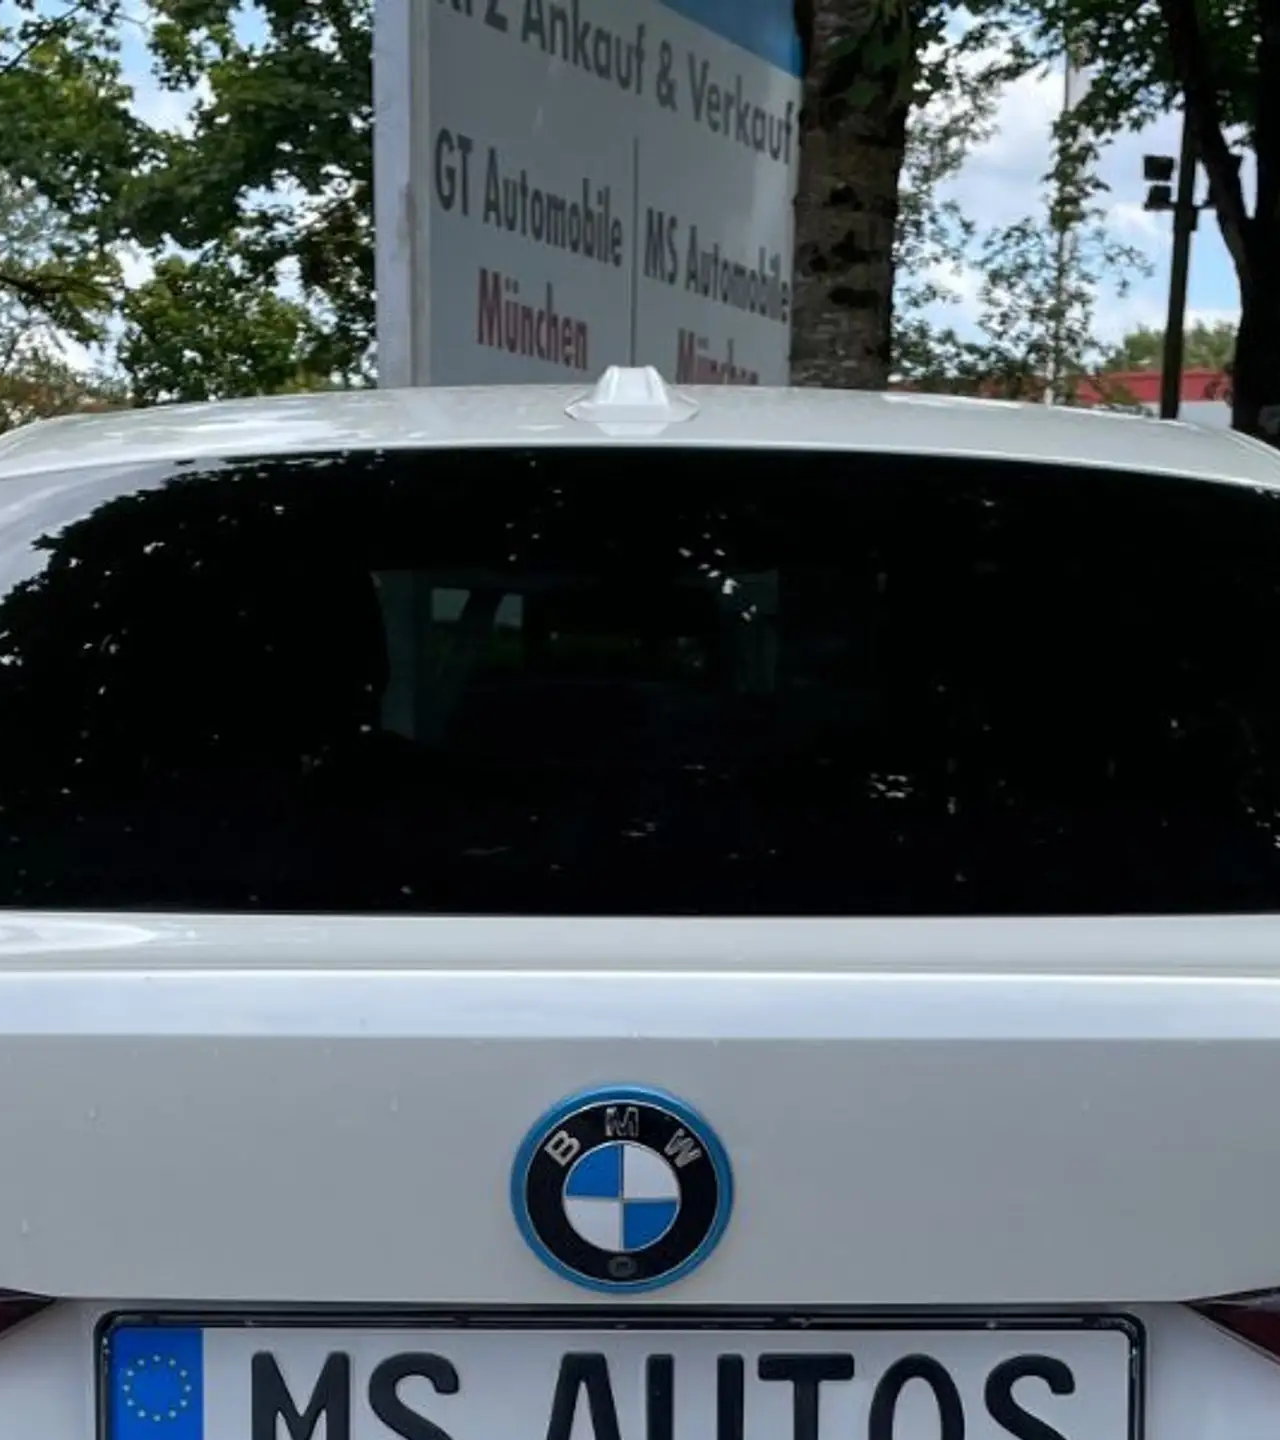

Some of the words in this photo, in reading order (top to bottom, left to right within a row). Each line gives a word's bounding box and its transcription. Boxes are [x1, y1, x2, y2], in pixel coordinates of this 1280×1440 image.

[521, 0, 646, 95] Ankauf
[655, 39, 678, 112] &
[687, 52, 794, 164] Verkauf
[434, 128, 474, 217] GT
[482, 146, 623, 268] Automobile
[476, 267, 588, 371] München
[644, 206, 678, 286] MS
[685, 224, 790, 325] Automobile
[544, 1106, 703, 1169] BMW
